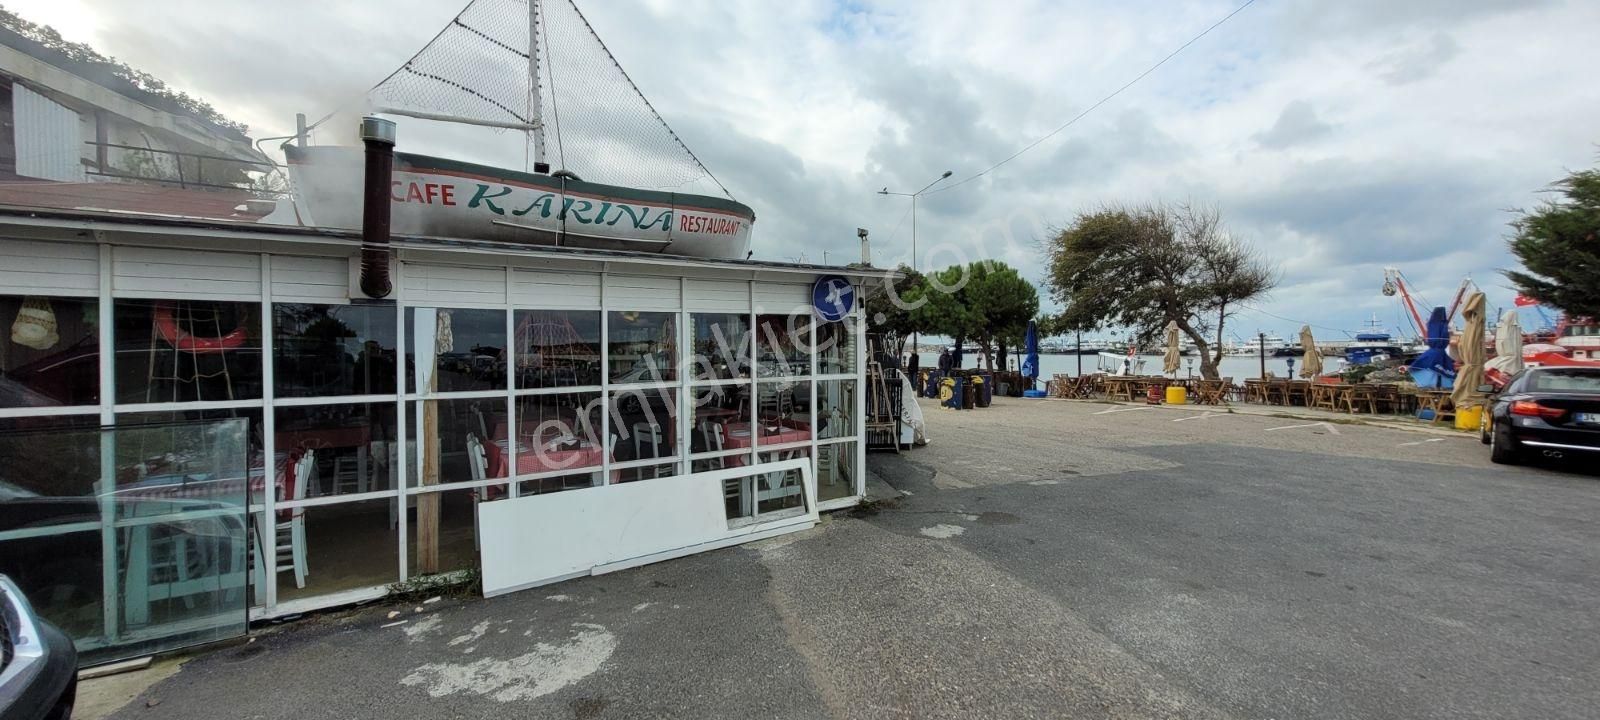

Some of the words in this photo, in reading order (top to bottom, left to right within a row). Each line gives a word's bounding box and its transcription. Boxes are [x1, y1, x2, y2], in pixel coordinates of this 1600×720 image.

[391, 181, 456, 206] CAFE
[468, 183, 673, 232] KARINA
[680, 214, 740, 236] RESTAURANT
